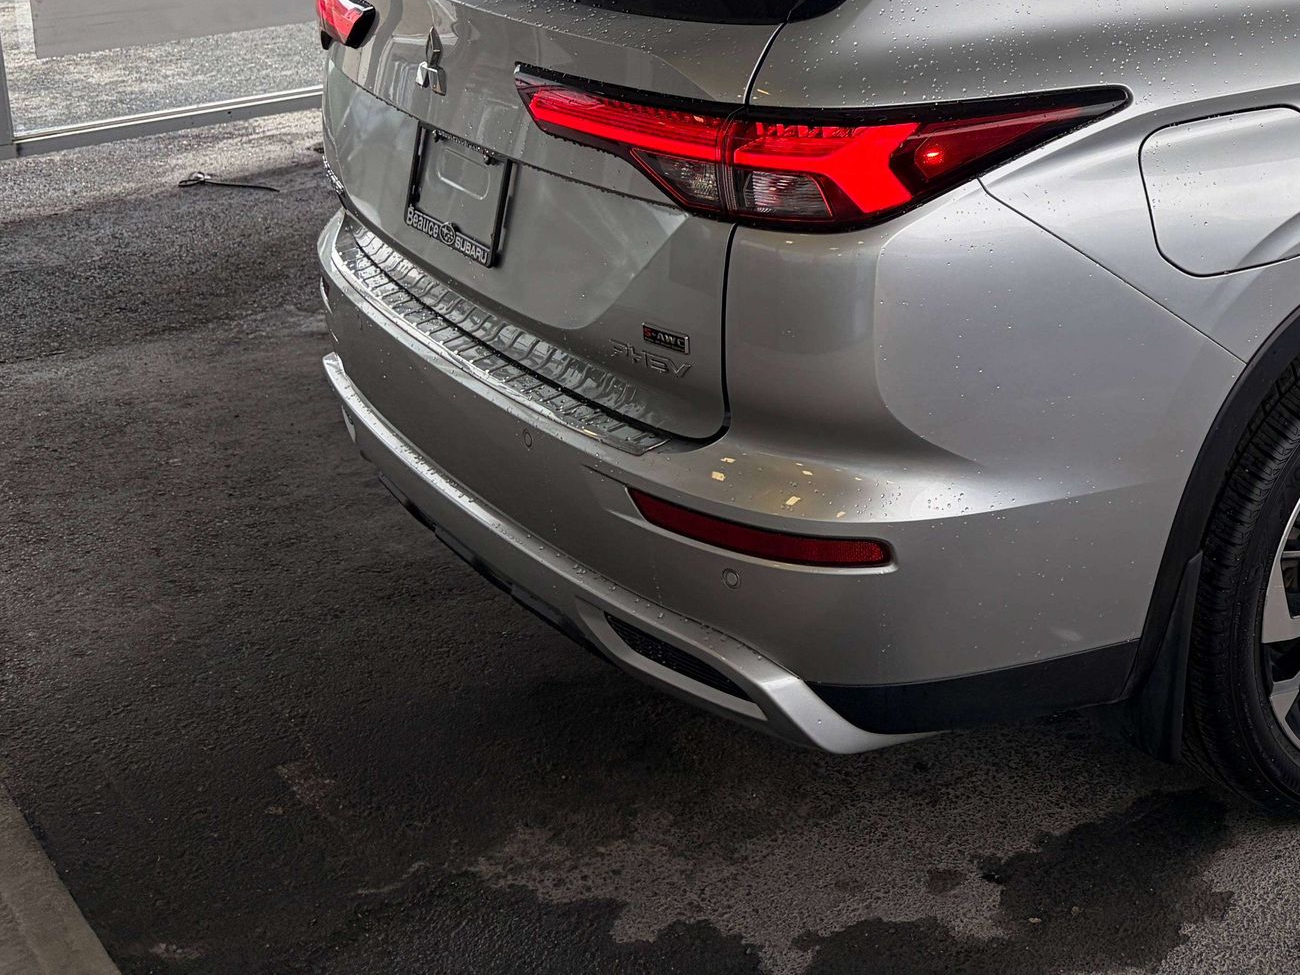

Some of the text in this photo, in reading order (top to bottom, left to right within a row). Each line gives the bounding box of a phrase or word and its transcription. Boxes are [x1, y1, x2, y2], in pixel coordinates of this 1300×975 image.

[406, 206, 488, 263] Beauce SUBARU
[644, 327, 685, 348] S-AWC
